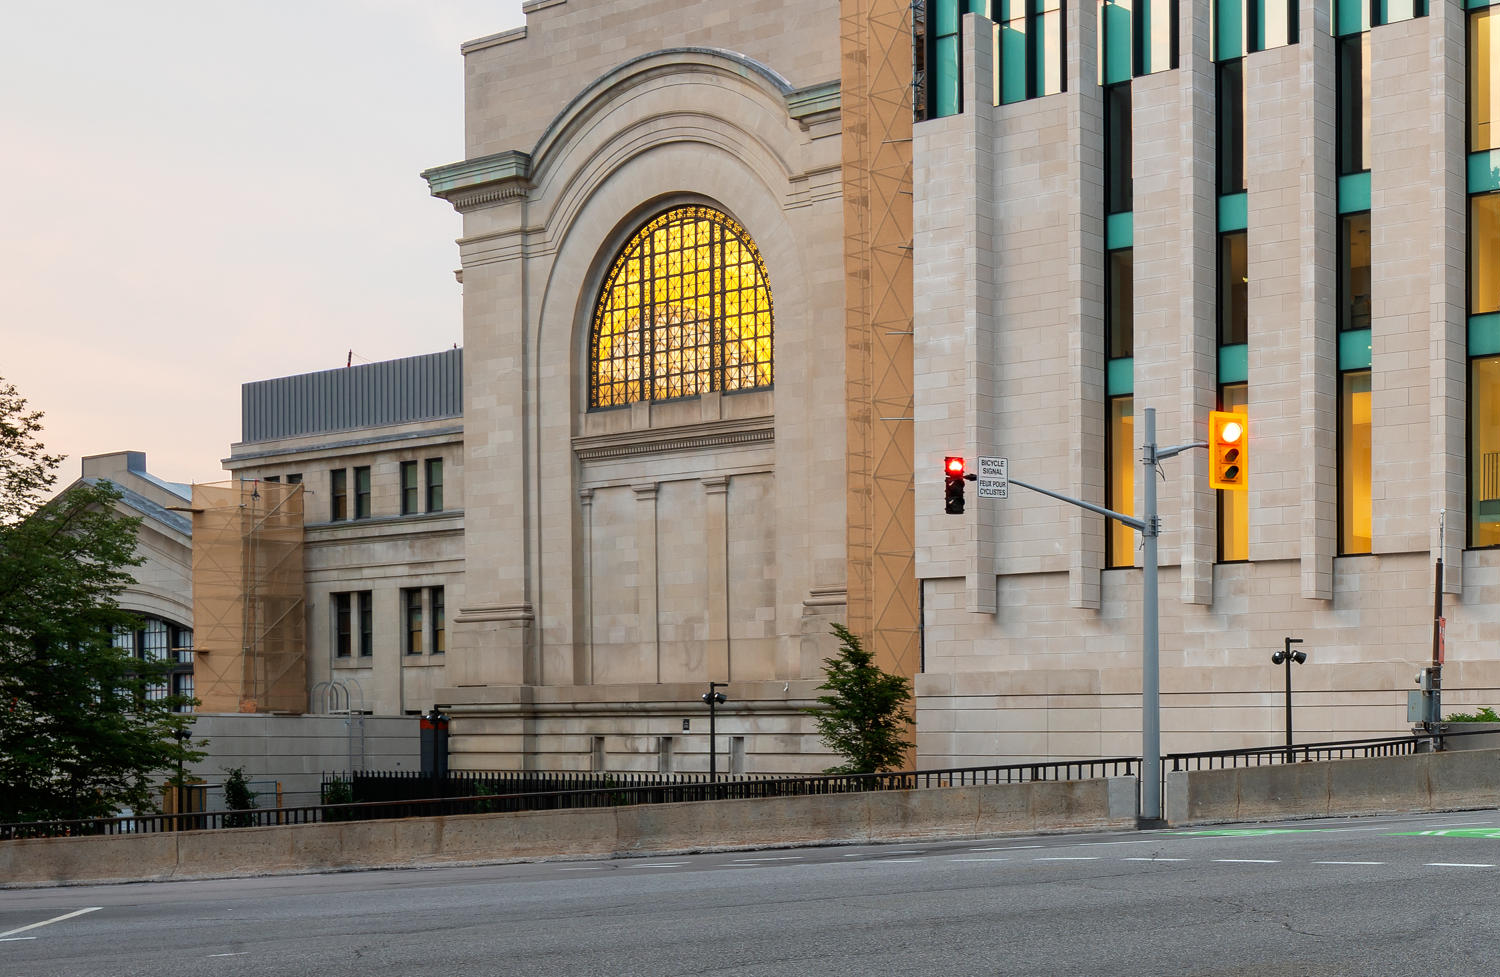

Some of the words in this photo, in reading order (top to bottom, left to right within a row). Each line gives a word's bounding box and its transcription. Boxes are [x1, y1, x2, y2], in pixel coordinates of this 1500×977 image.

[981, 459, 1005, 467] BICYCLE
[982, 467, 1003, 475] SIGNAL
[980, 479, 991, 487] FEUX
[992, 480, 1006, 488] POUR
[980, 488, 1006, 496] CYCLISTES
